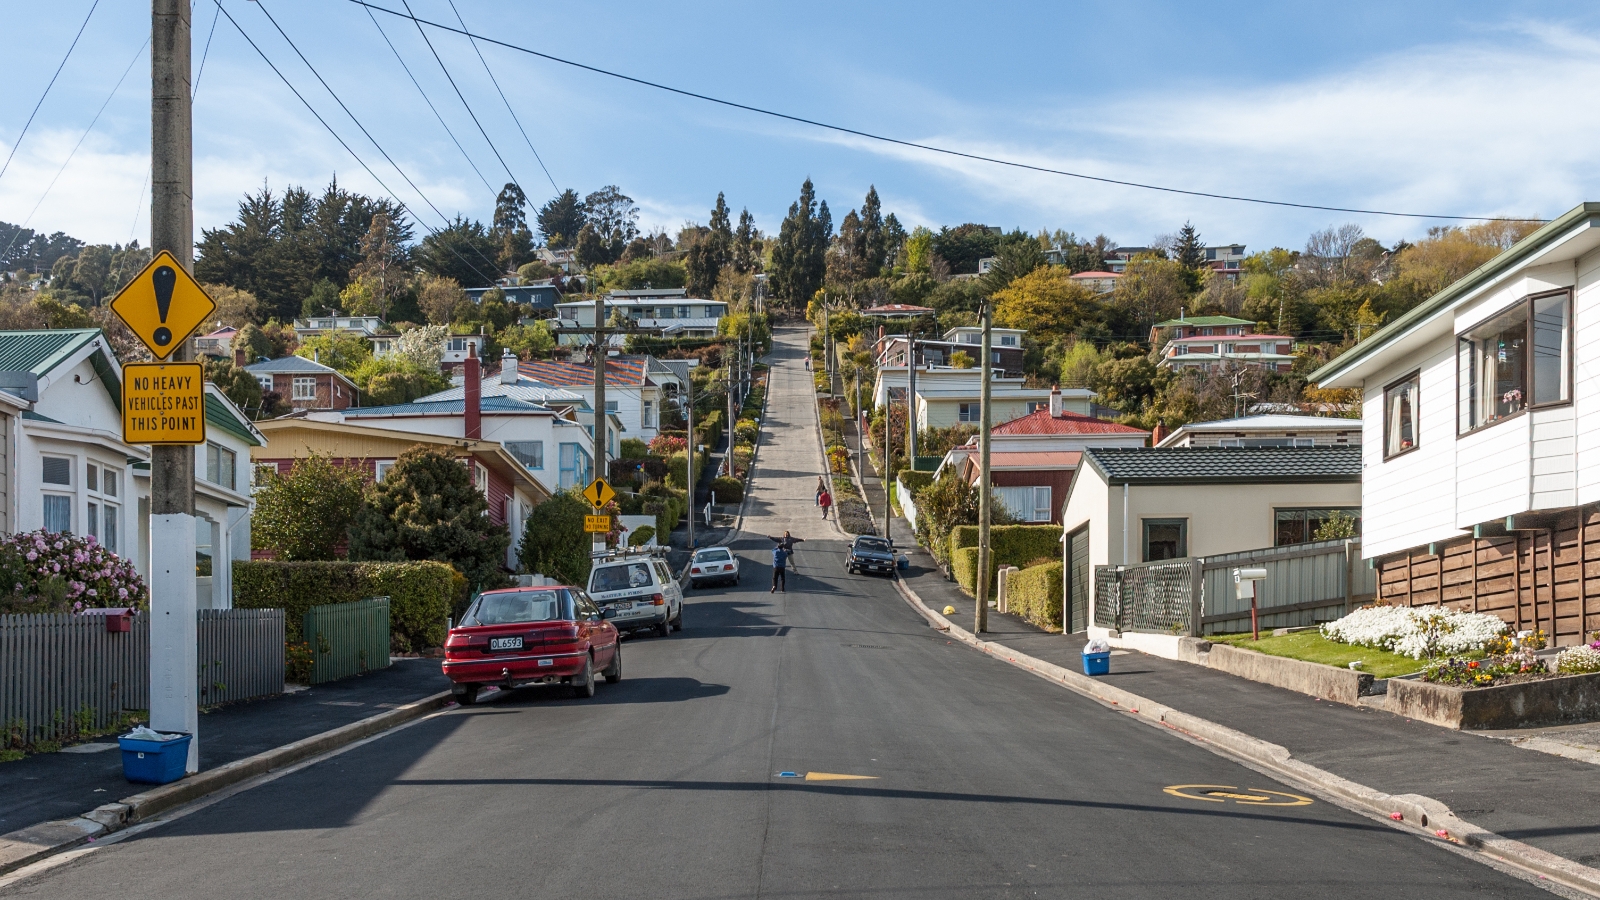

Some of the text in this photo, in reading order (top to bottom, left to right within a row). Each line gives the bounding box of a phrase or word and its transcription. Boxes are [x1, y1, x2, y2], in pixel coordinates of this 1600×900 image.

[134, 376, 191, 390] NO HEAVY
[129, 396, 198, 410] VEHICLES PAST
[131, 417, 196, 430] THIS POINT
